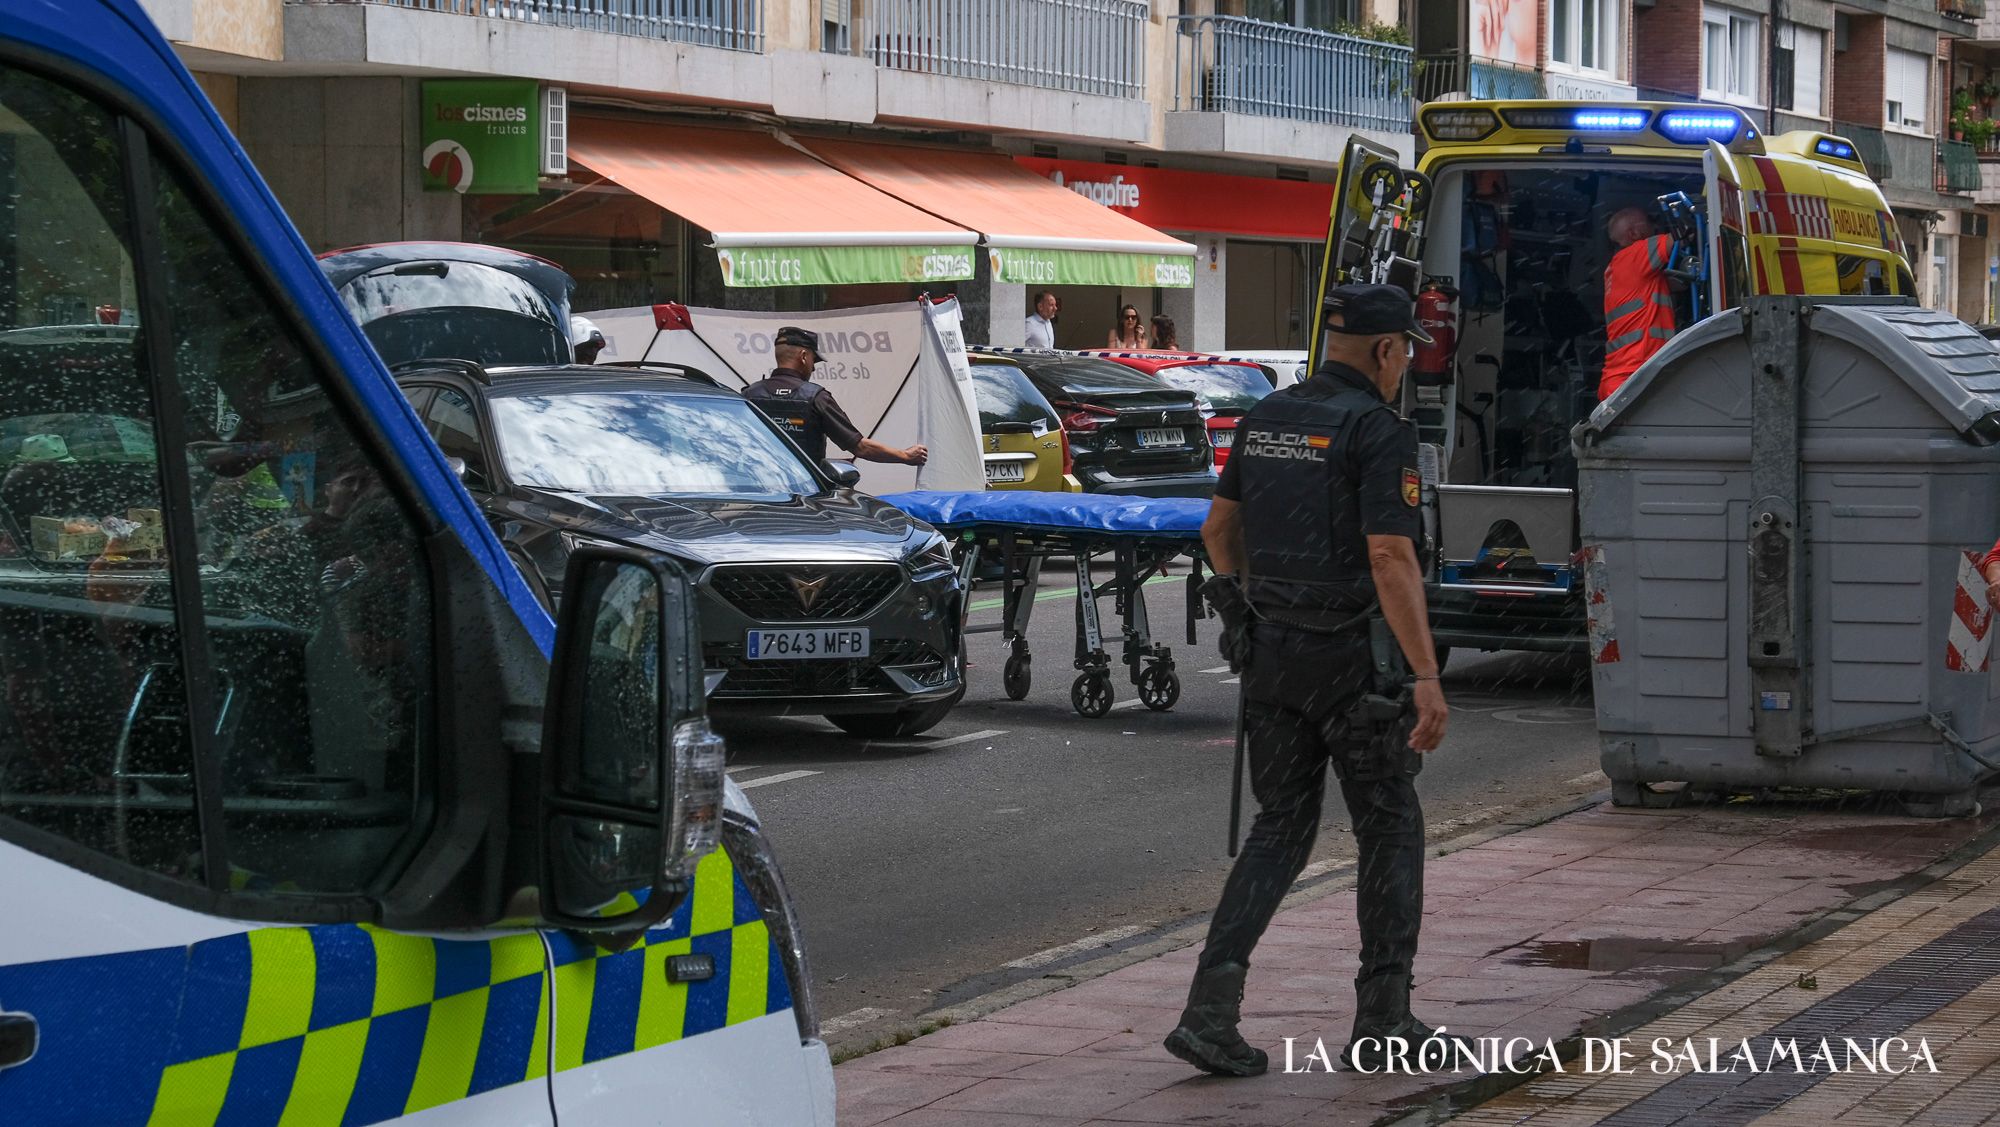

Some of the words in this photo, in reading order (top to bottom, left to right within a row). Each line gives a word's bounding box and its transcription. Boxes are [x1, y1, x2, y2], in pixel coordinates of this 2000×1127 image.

[487, 124, 527, 135] frutas
[1074, 175, 1140, 208] mapfre
[1833, 207, 1880, 240] AMBULANCIA
[739, 252, 801, 281] frutas
[1006, 253, 1055, 281] frutas
[1143, 430, 1164, 443] 8121
[1165, 429, 1183, 442] MKN
[1243, 445, 1326, 462] NACIONAL
[985, 464, 997, 477] 57
[999, 463, 1019, 477] CKV
[763, 632, 816, 655] 7643
[824, 632, 862, 653] MFB
